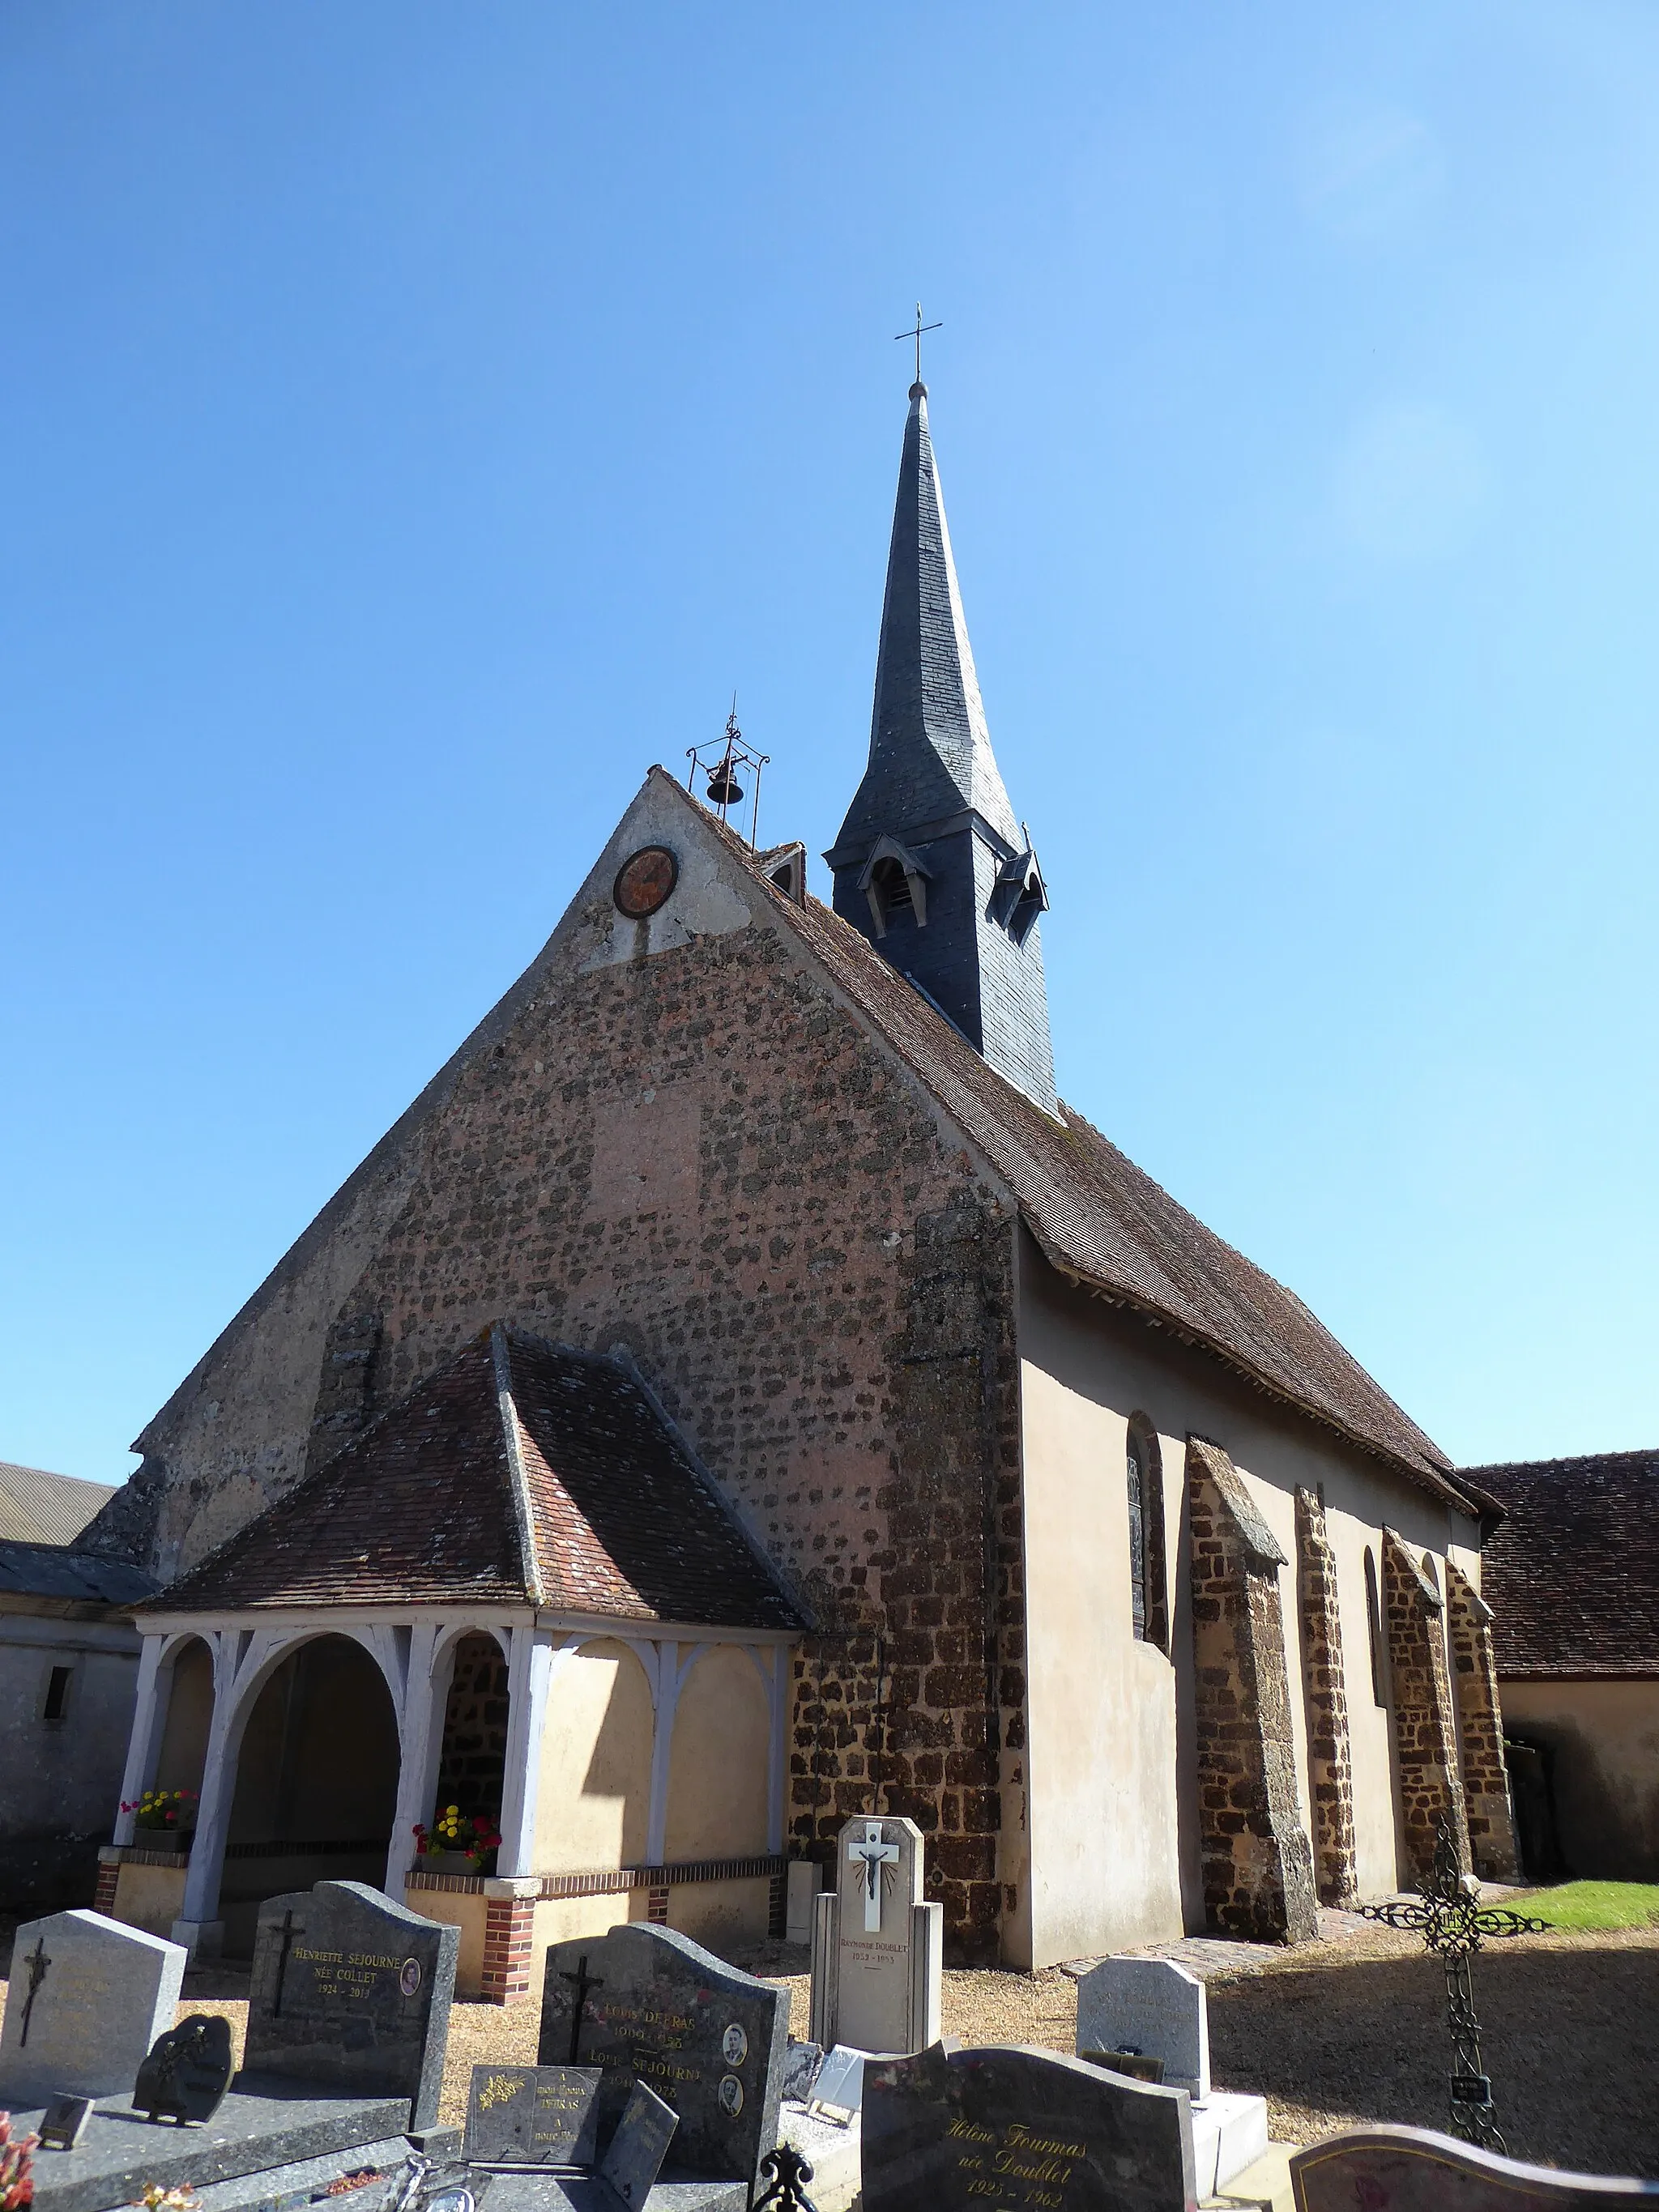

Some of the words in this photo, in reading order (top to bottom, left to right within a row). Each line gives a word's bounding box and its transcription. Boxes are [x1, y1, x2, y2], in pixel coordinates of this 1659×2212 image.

[876, 1941, 908, 1952] DOUBLET
[295, 1948, 343, 1963] HENRIETTE
[337, 1969, 377, 1983] COLLET
[318, 1984, 337, 1994] 1924
[992, 2150, 1073, 2184] Doublet
